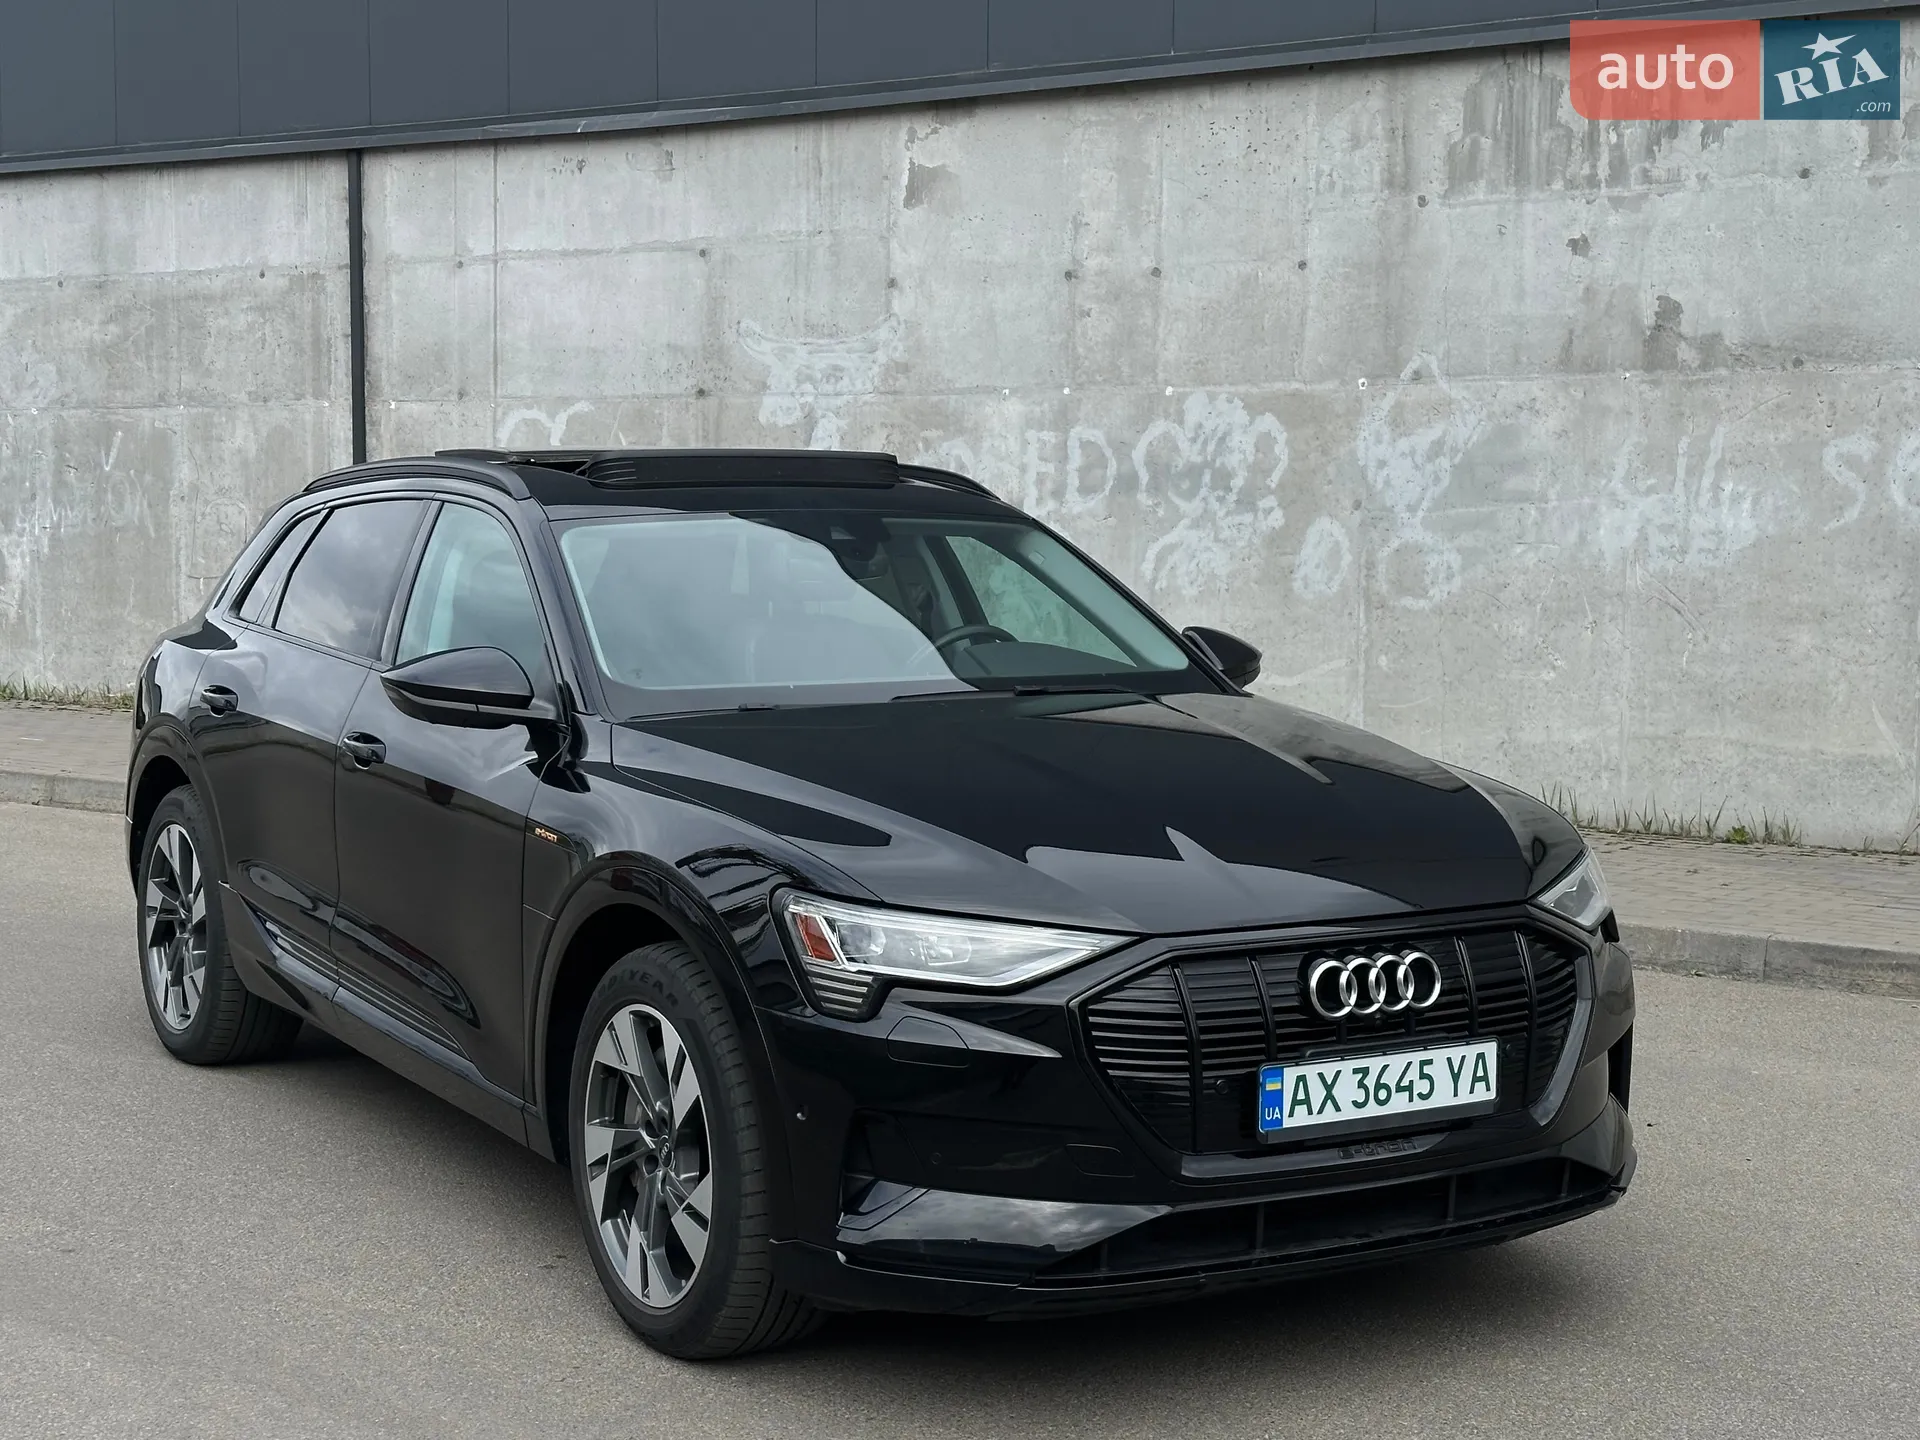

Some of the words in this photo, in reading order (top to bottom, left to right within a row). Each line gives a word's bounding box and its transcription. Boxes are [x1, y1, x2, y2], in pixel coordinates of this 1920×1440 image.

[1287, 1069, 1342, 1118] AX
[1351, 1058, 1436, 1110] 3645
[1446, 1051, 1492, 1098] YA
[1265, 1105, 1282, 1121] UA
